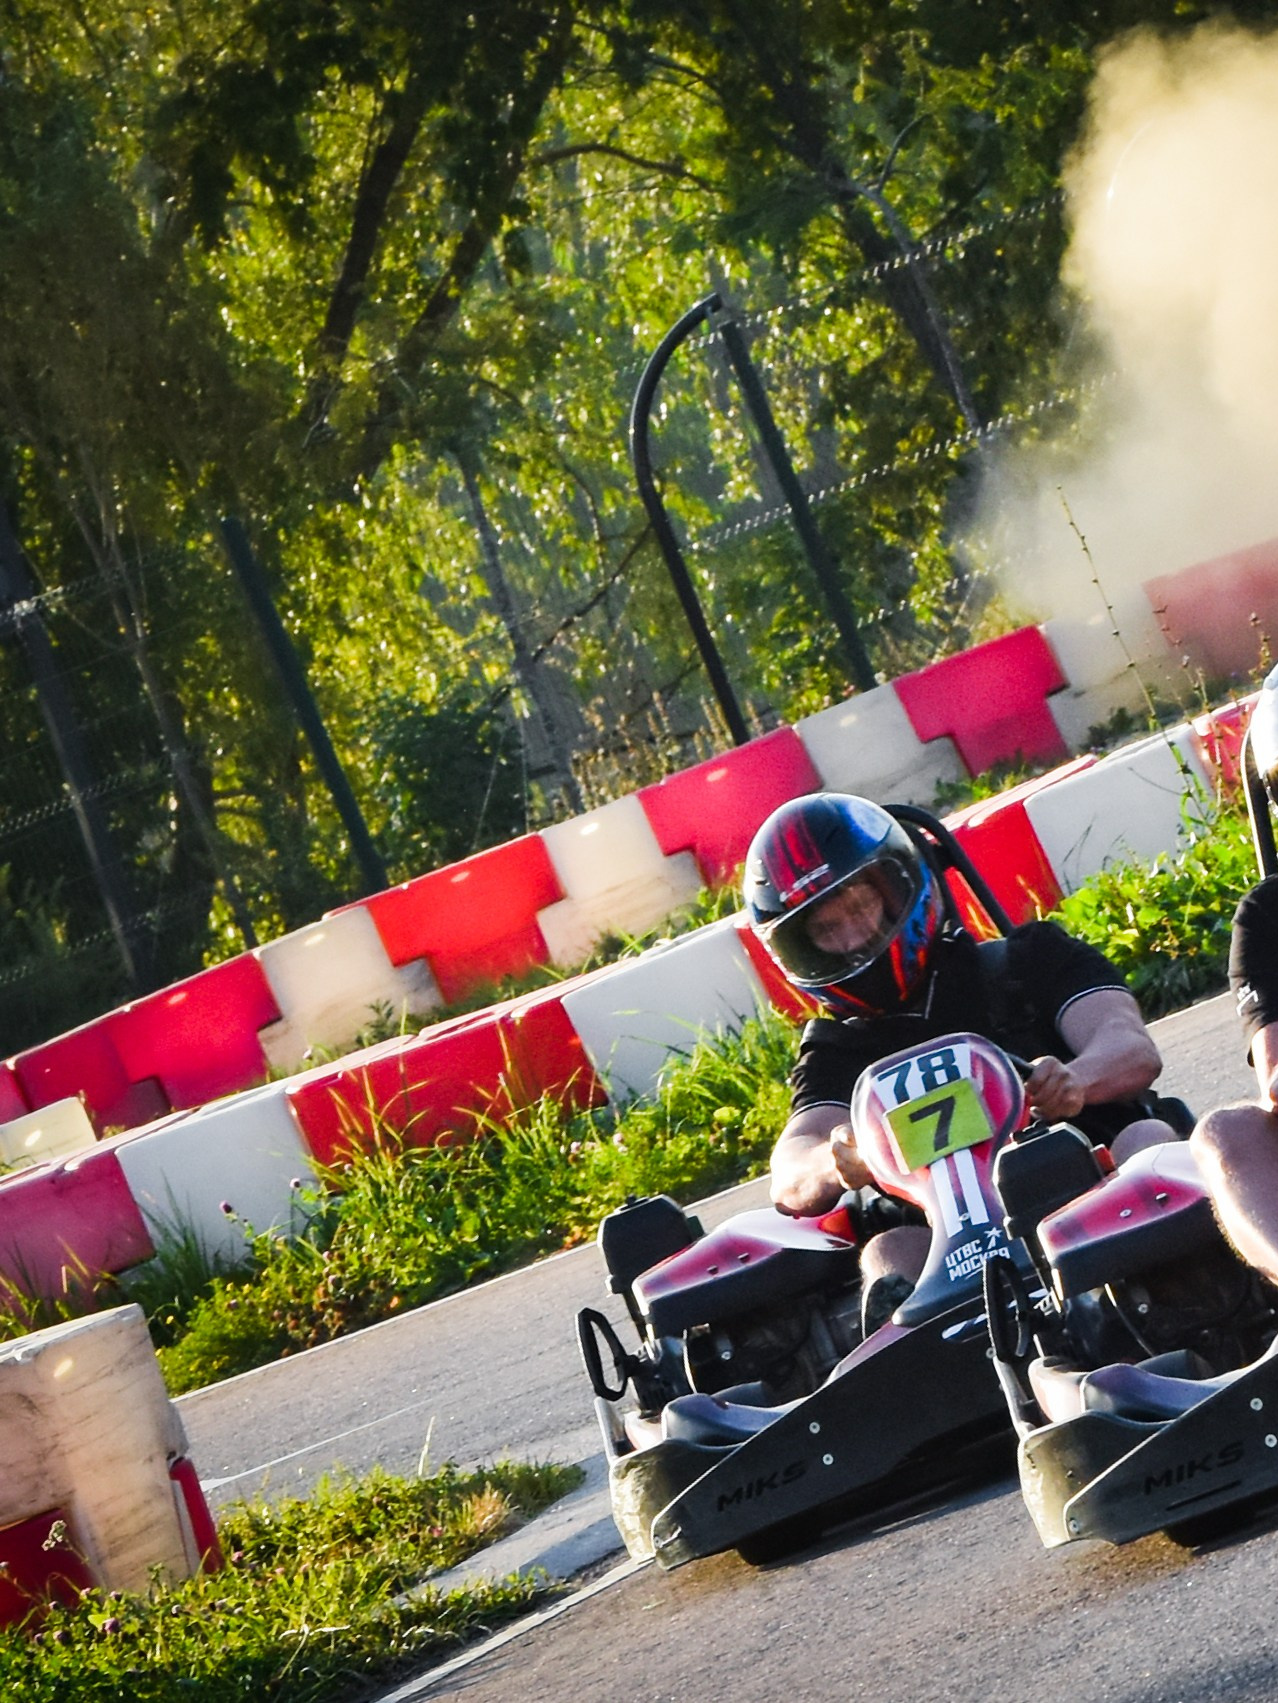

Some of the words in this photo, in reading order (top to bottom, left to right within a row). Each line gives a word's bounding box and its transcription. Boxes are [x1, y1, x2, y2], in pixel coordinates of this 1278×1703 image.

[877, 1048, 961, 1104] 78
[908, 1095, 956, 1152] 7
[717, 1460, 807, 1512] MIKS
[1144, 1441, 1244, 1495] MIKS
